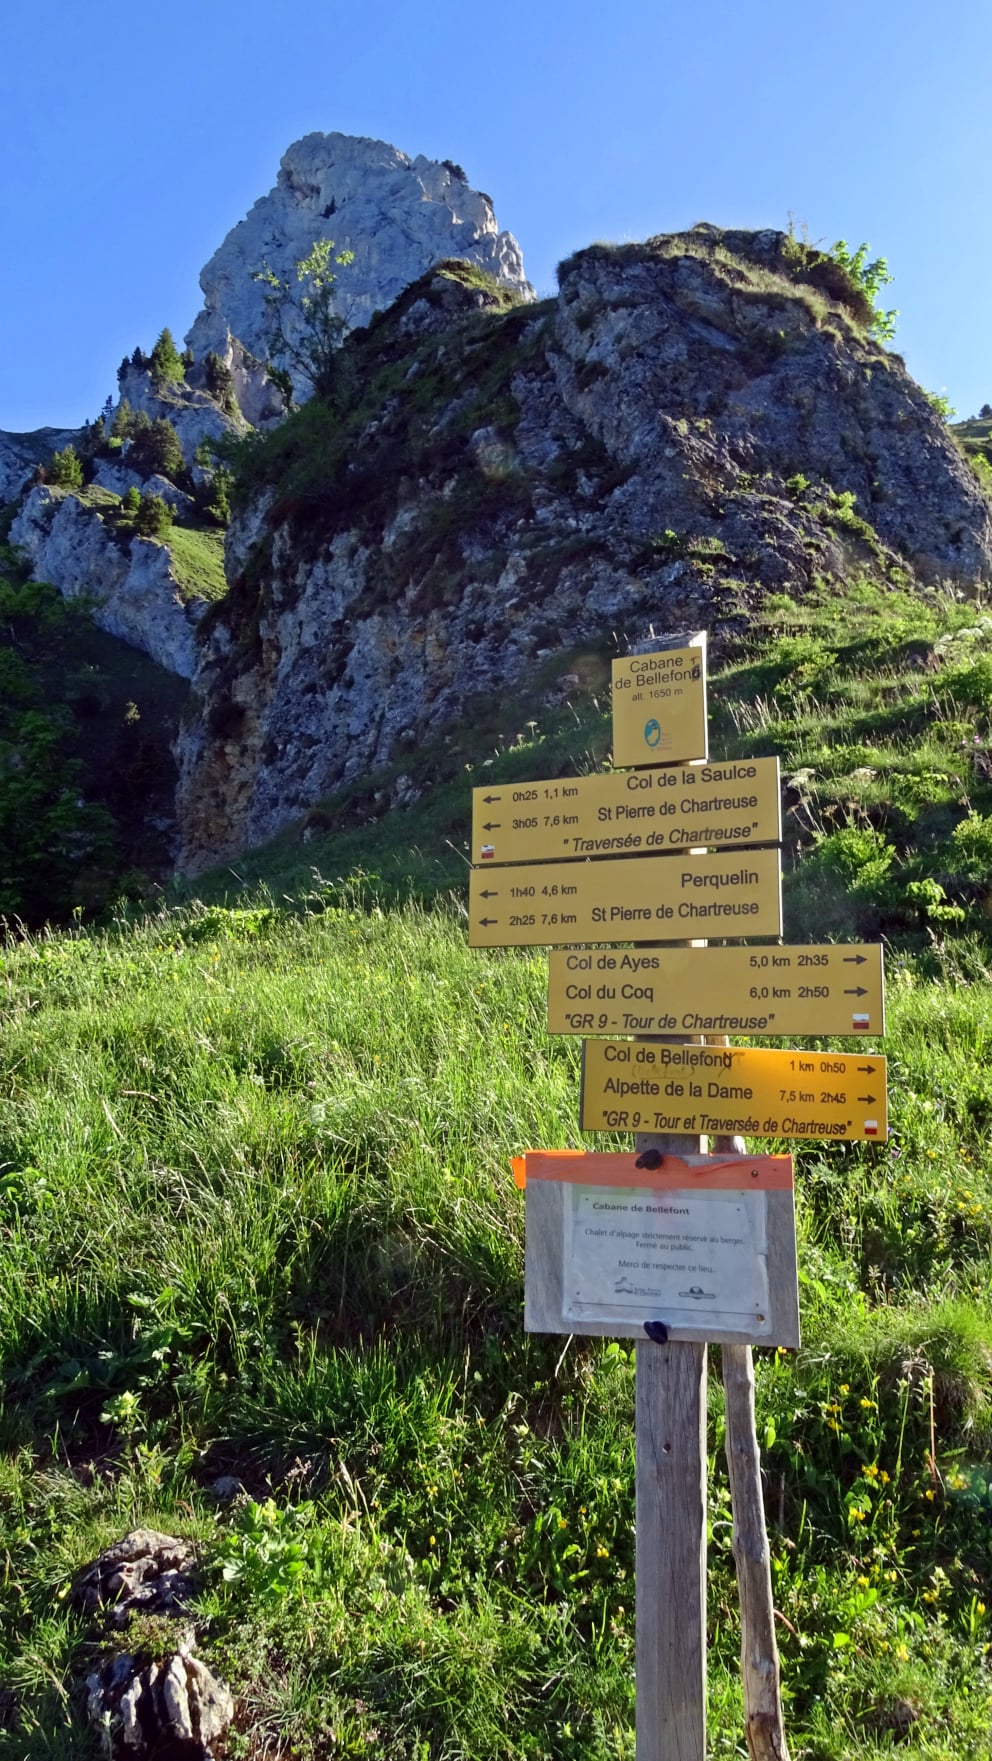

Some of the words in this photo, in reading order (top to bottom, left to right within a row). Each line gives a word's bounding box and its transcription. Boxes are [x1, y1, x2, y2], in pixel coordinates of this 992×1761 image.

[630, 657, 683, 673] Cabane
[615, 676, 631, 689] de
[649, 688, 671, 699] 1650
[627, 775, 653, 790] Col
[658, 773, 677, 788] de
[682, 771, 695, 785] la
[701, 765, 757, 783] Saulce
[512, 790, 538, 802] 0h25
[544, 789, 558, 800] 1,1
[562, 786, 578, 797] km
[598, 807, 613, 821] St
[616, 804, 656, 820] Pierre
[659, 801, 676, 816] de
[680, 795, 757, 814] Chartreuse
[512, 817, 538, 829] 3h05
[544, 816, 560, 828] 7,6
[563, 814, 579, 825] km
[646, 831, 663, 846] de
[669, 822, 758, 843] Chartreuse"
[681, 869, 759, 890] Perquelin
[510, 886, 535, 898] 1h40
[542, 885, 558, 897] 4,6
[561, 884, 577, 895] km
[591, 908, 607, 922] St
[610, 906, 652, 921] Pierre
[655, 904, 673, 919] de
[677, 900, 759, 917] Chartreuse
[509, 914, 535, 926] 2h25
[542, 914, 557, 925] 7,6
[561, 912, 577, 924] km
[566, 955, 592, 970] Col
[597, 954, 617, 969] de
[620, 954, 660, 972] Ayes
[750, 956, 769, 969] 5,0
[772, 955, 790, 967] km
[797, 954, 829, 967] 2h35
[566, 985, 591, 999] Col
[597, 985, 616, 999] du
[621, 984, 654, 1002] Coq
[750, 987, 769, 1000] 6,0
[772, 986, 790, 998] km
[798, 987, 829, 998] 2h50
[565, 1014, 595, 1029] "GR
[598, 1014, 608, 1028] 9
[623, 1014, 654, 1029] Tour
[658, 1014, 677, 1029] de
[681, 1013, 775, 1029] Chartreuse"
[604, 1046, 631, 1063] Col
[636, 1047, 656, 1064] de
[790, 1060, 795, 1071] 1
[798, 1061, 814, 1072] km
[820, 1062, 846, 1074] 0h50
[604, 1078, 660, 1097] Alpette
[664, 1080, 685, 1096] de
[689, 1082, 703, 1096] la
[707, 1084, 753, 1100] Dame
[779, 1090, 796, 1103] 7,5
[799, 1091, 814, 1102] km
[820, 1092, 846, 1104] 2h45
[602, 1111, 629, 1127] "GR
[632, 1113, 641, 1127] 9
[653, 1113, 681, 1129] Tour
[684, 1116, 696, 1129] et
[699, 1115, 760, 1133] Traversée
[763, 1116, 778, 1132] de
[782, 1118, 852, 1135] Chartreuse"
[592, 1202, 628, 1212] Cabane
[631, 1204, 643, 1212] de
[645, 1205, 690, 1215] Bellefont
[584, 1228, 607, 1236] Chalet
[642, 1230, 680, 1240] strictement
[636, 1241, 657, 1249] Fermé
[618, 1260, 640, 1268] Merci
[652, 1264, 686, 1273] respecter
